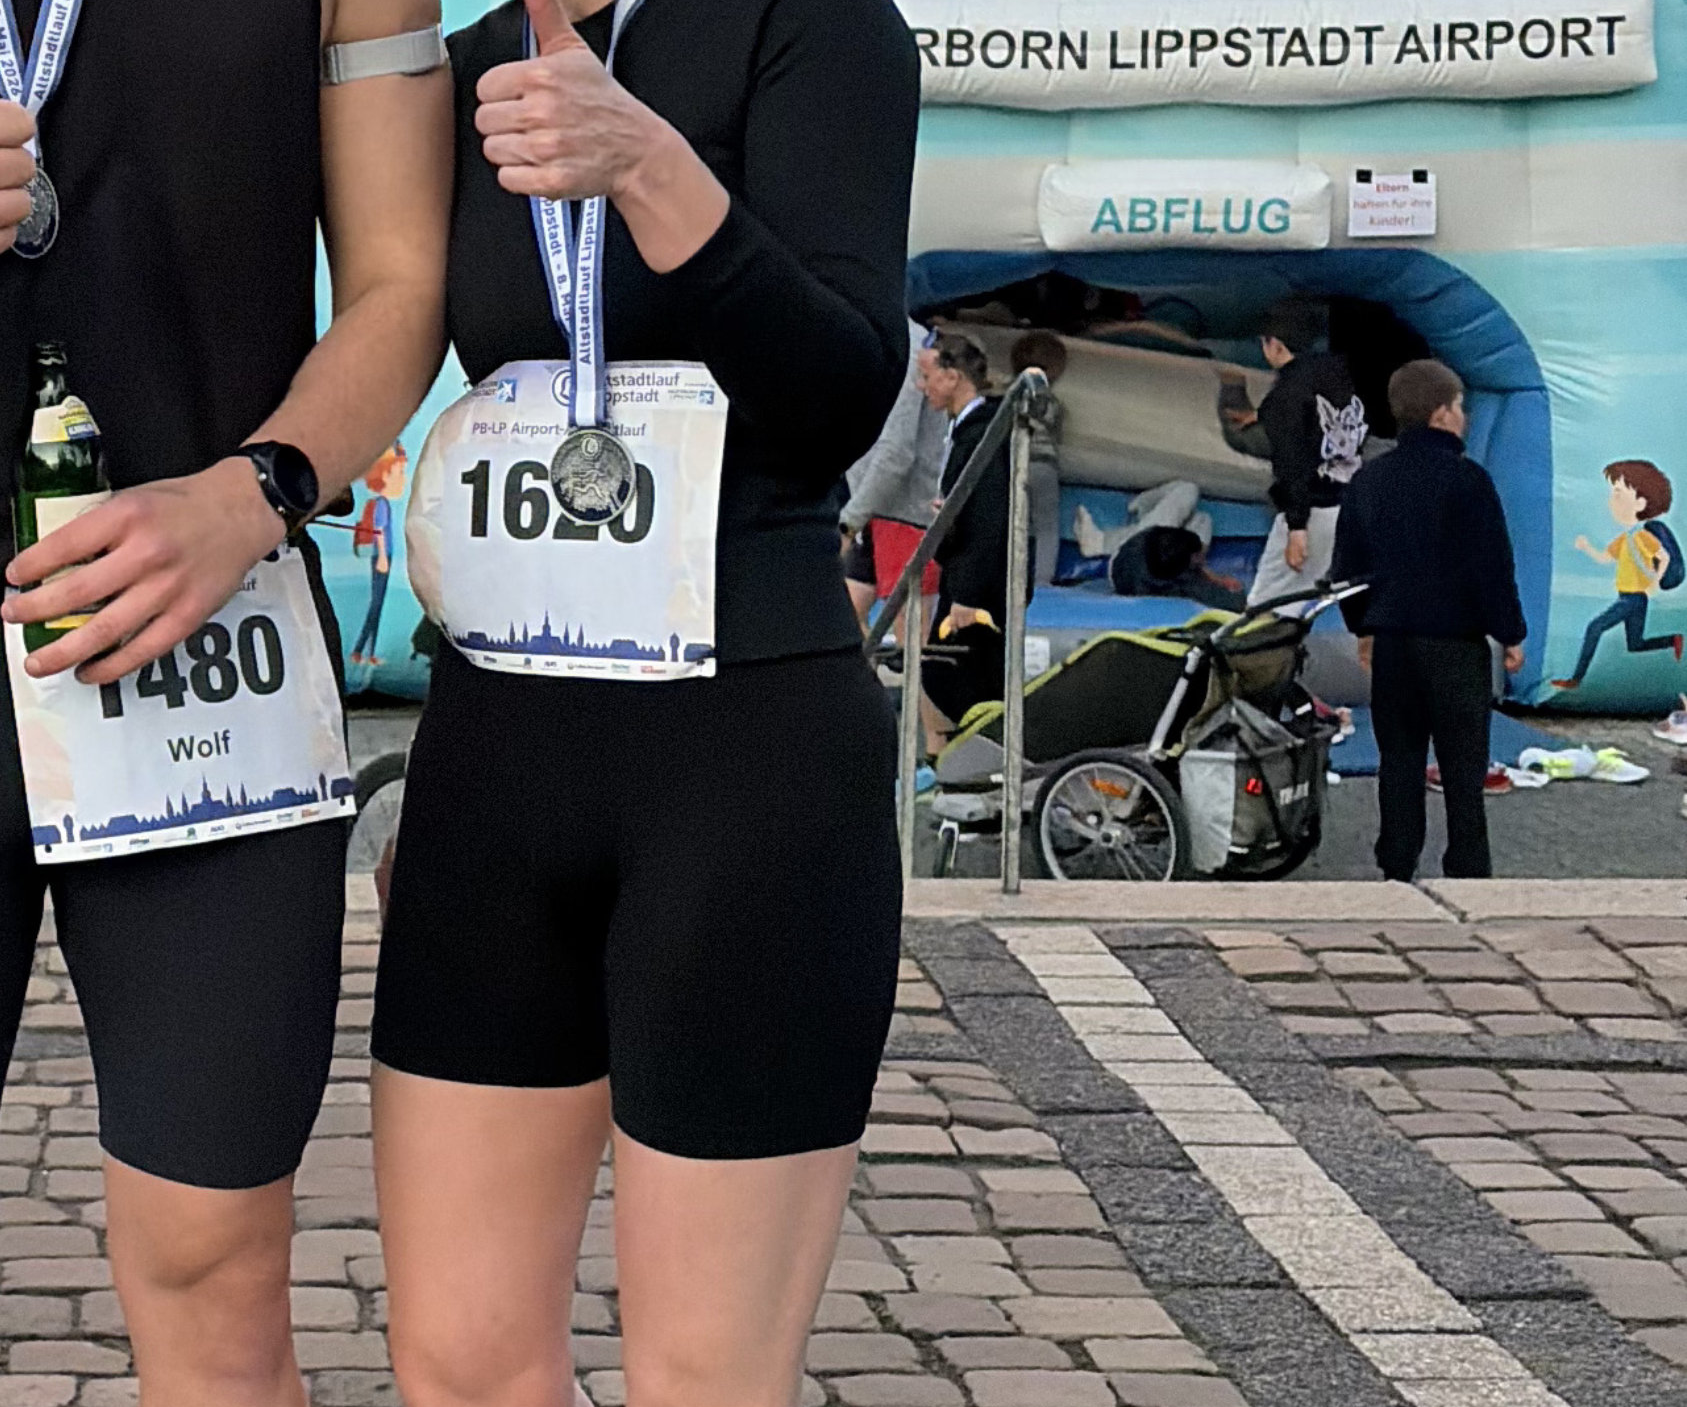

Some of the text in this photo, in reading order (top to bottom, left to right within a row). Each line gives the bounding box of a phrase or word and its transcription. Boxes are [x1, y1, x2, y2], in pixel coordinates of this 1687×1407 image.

[34, 1, 68, 100] Altstadtlauf
[911, 14, 1626, 71] RBORN LIPPSTADT AIRPORT
[1, 58, 23, 97] 2026
[543, 199, 561, 257] ppstadt
[1091, 197, 1291, 236] ABFLUG
[578, 200, 596, 365] Altstadtlauf Lippsta
[606, 371, 681, 387] tstadtlauf
[606, 389, 659, 406] ppstadt
[472, 421, 508, 435] PB-LP
[460, 459, 656, 544] 160
[167, 730, 231, 763] Wolf
